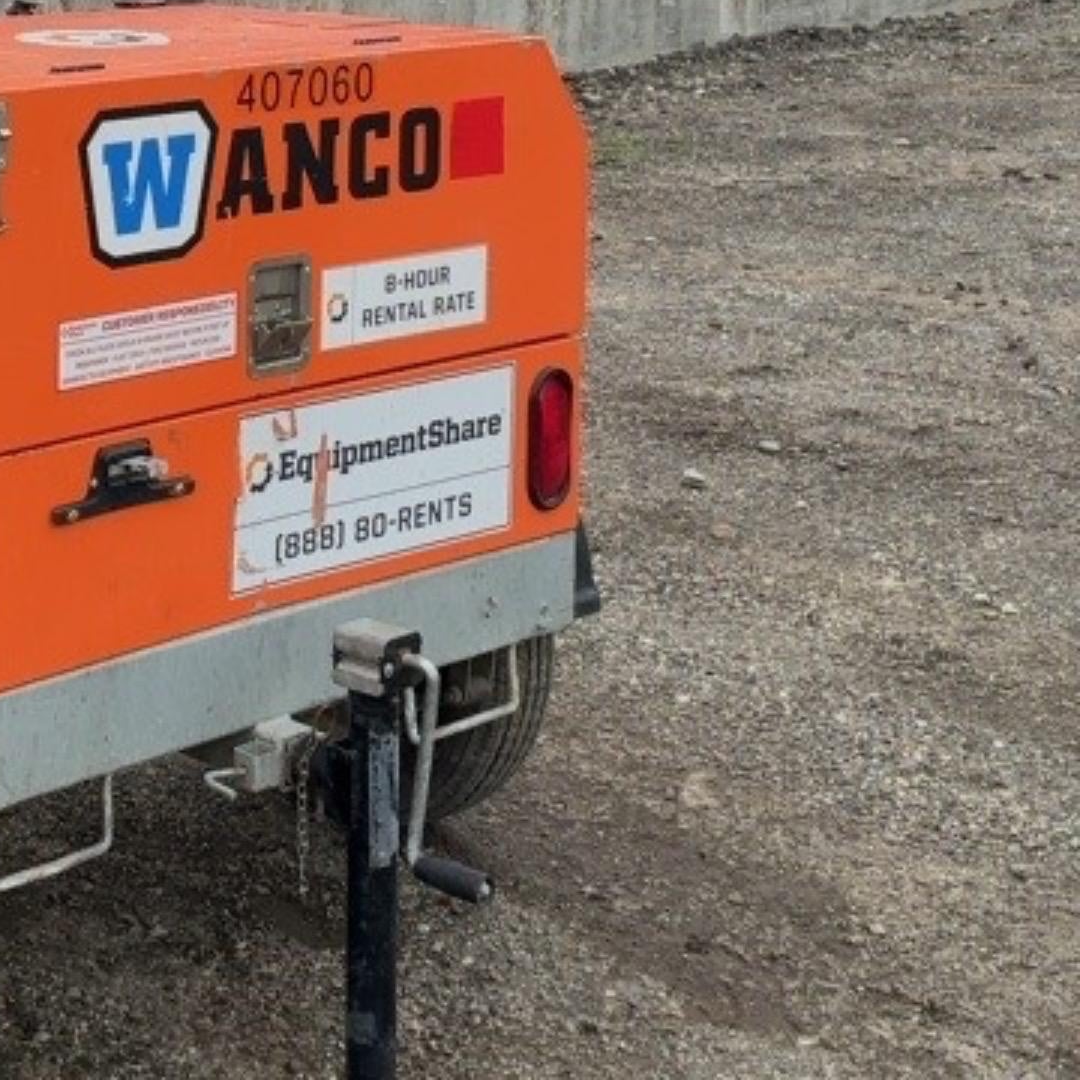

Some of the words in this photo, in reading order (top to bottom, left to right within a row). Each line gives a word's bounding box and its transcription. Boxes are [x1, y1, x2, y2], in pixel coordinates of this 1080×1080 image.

[235, 62, 375, 113] 407060
[102, 106, 442, 237] WANCO
[383, 265, 451, 295] 8-HOUR
[361, 300, 427, 329] RENTAL
[433, 289, 476, 316] RATE
[275, 520, 345, 564] (888)
[353, 492, 473, 544] 80-RENTS
